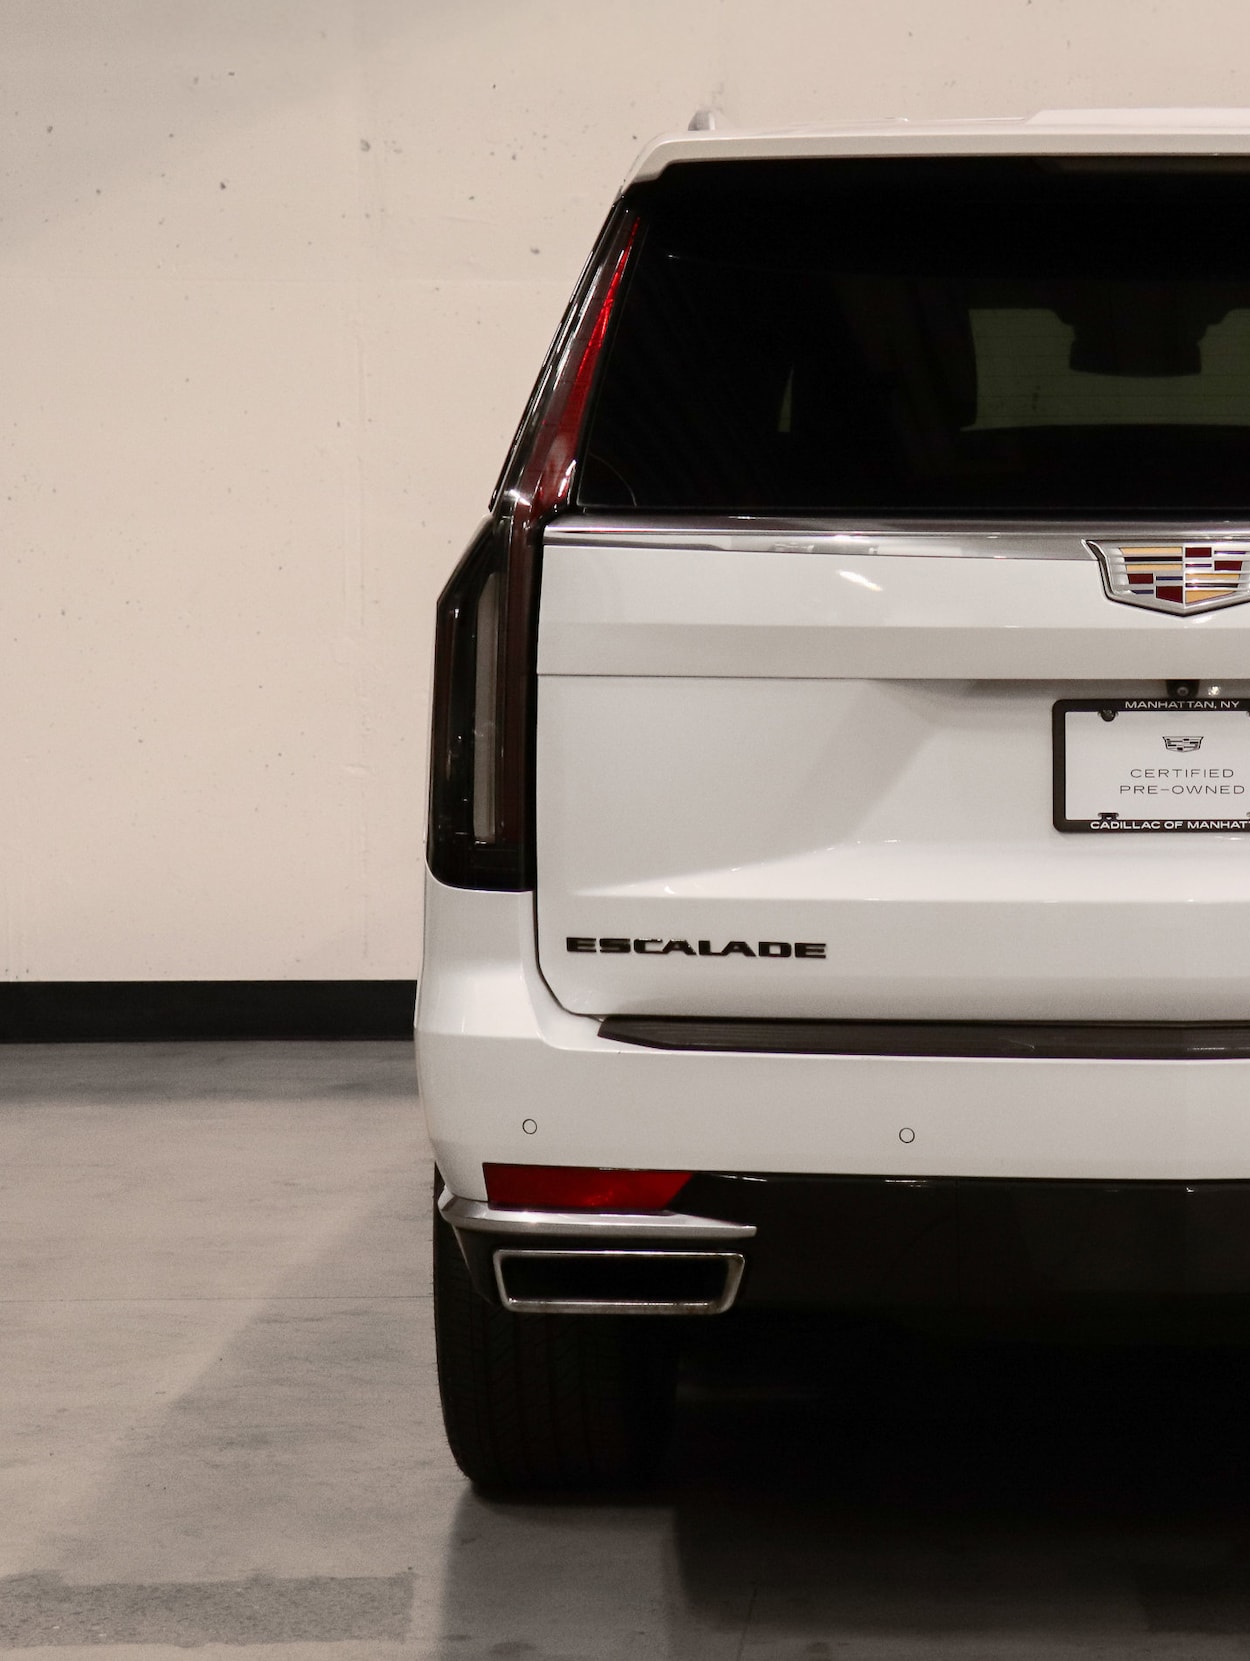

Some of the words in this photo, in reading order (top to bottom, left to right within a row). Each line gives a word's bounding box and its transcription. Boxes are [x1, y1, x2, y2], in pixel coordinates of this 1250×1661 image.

[1124, 700, 1217, 710] MANHATTAN,
[1221, 700, 1240, 709] NY
[1130, 768, 1235, 779] CERTIFIED
[1119, 785, 1246, 795] PRE-OWNED
[1090, 820, 1161, 830] CADILLAC
[1164, 820, 1183, 830] OF
[566, 936, 827, 959] ESCALADE
